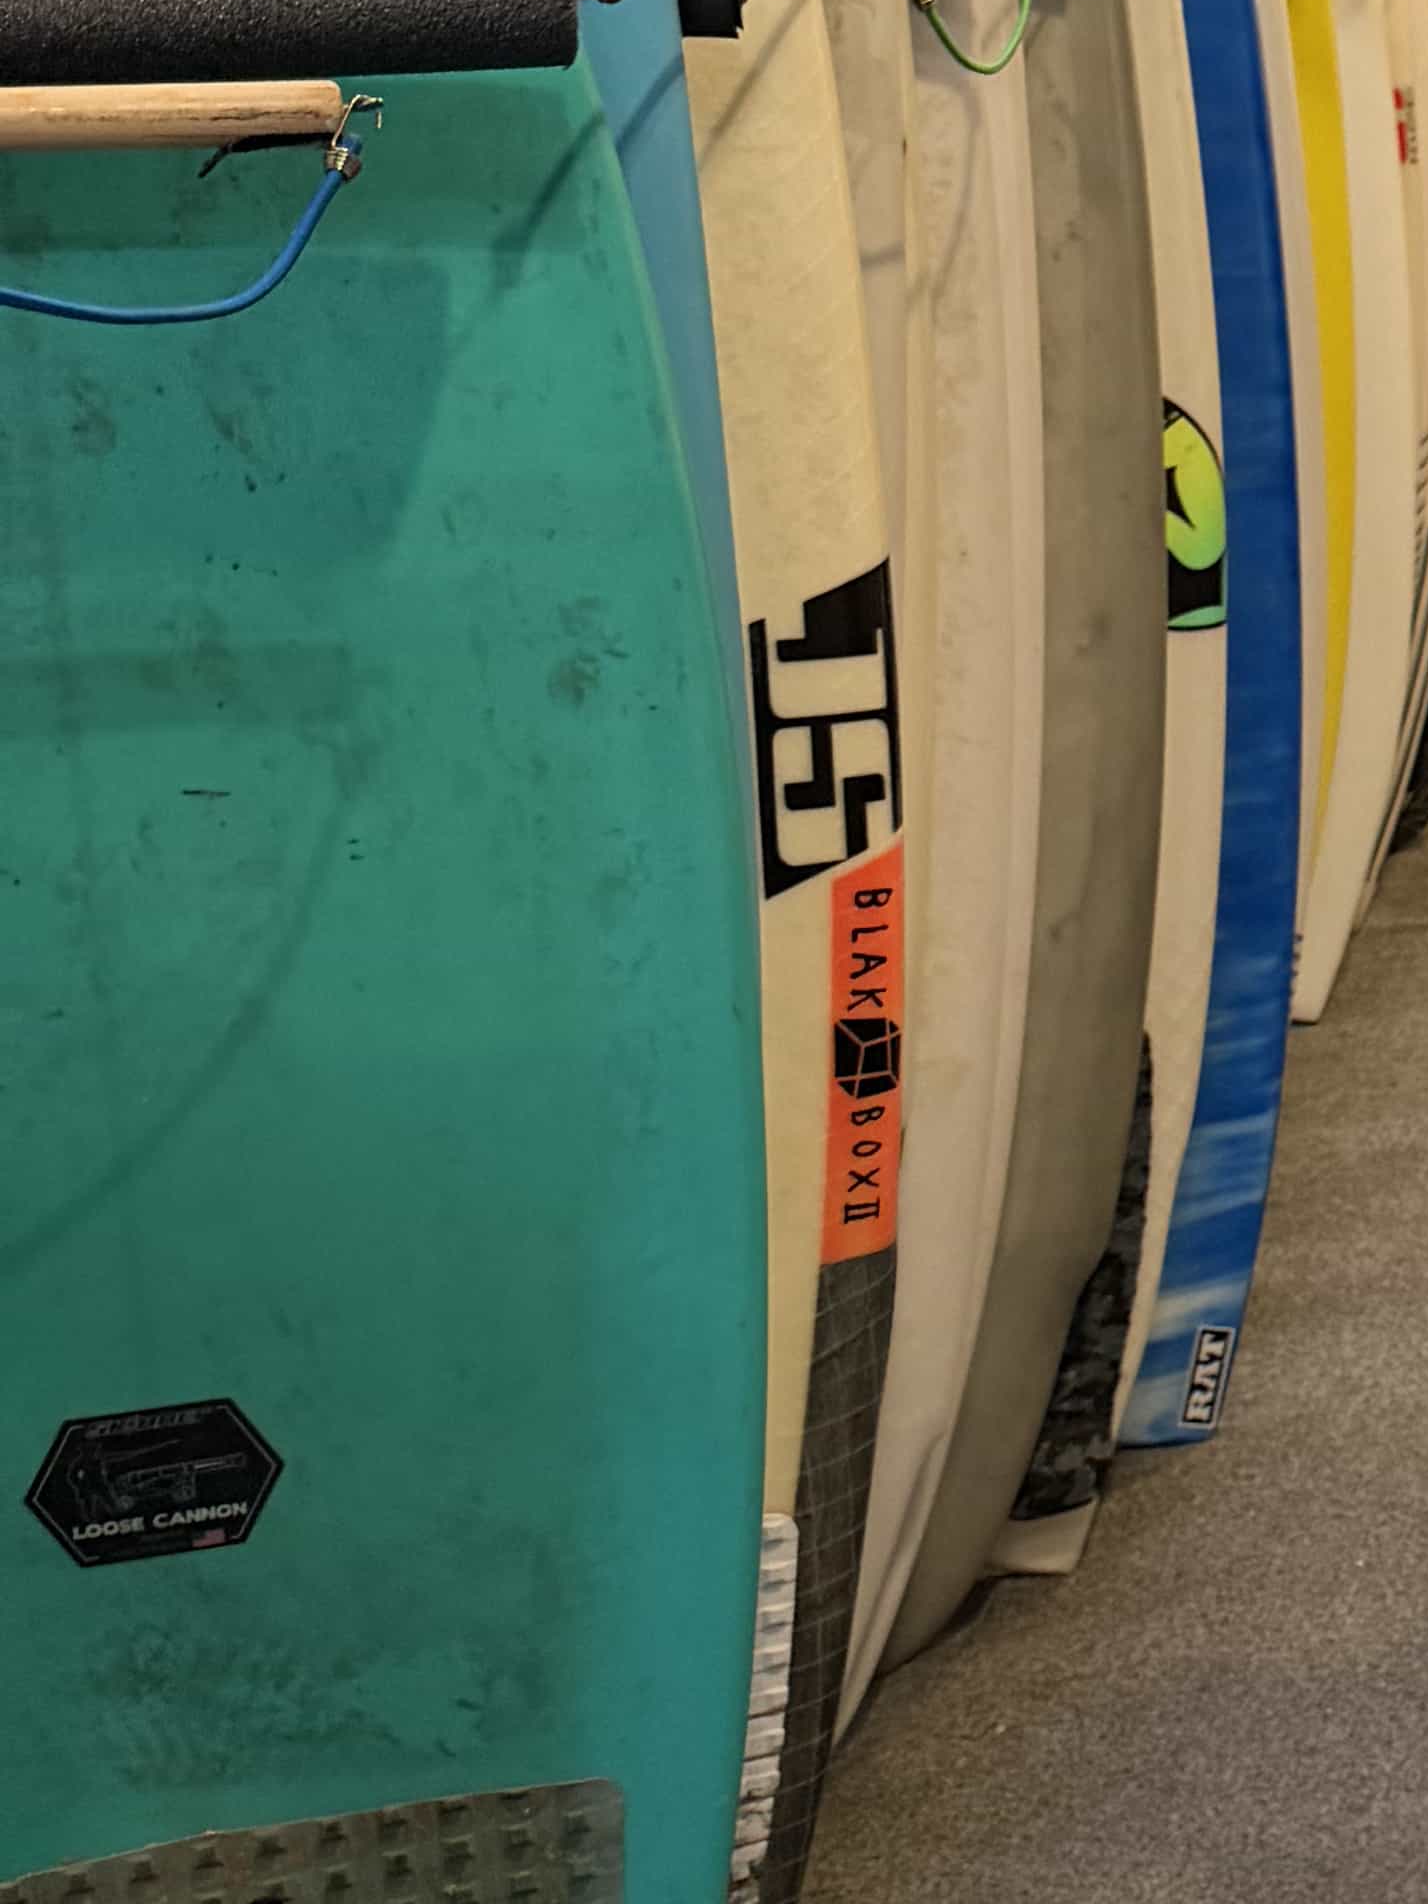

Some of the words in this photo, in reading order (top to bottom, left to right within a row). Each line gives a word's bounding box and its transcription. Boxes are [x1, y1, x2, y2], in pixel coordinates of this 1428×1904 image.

[847, 887, 893, 1011] BLAK
[72, 1515, 146, 1541] LOOSE
[151, 1501, 249, 1529] CANNON
